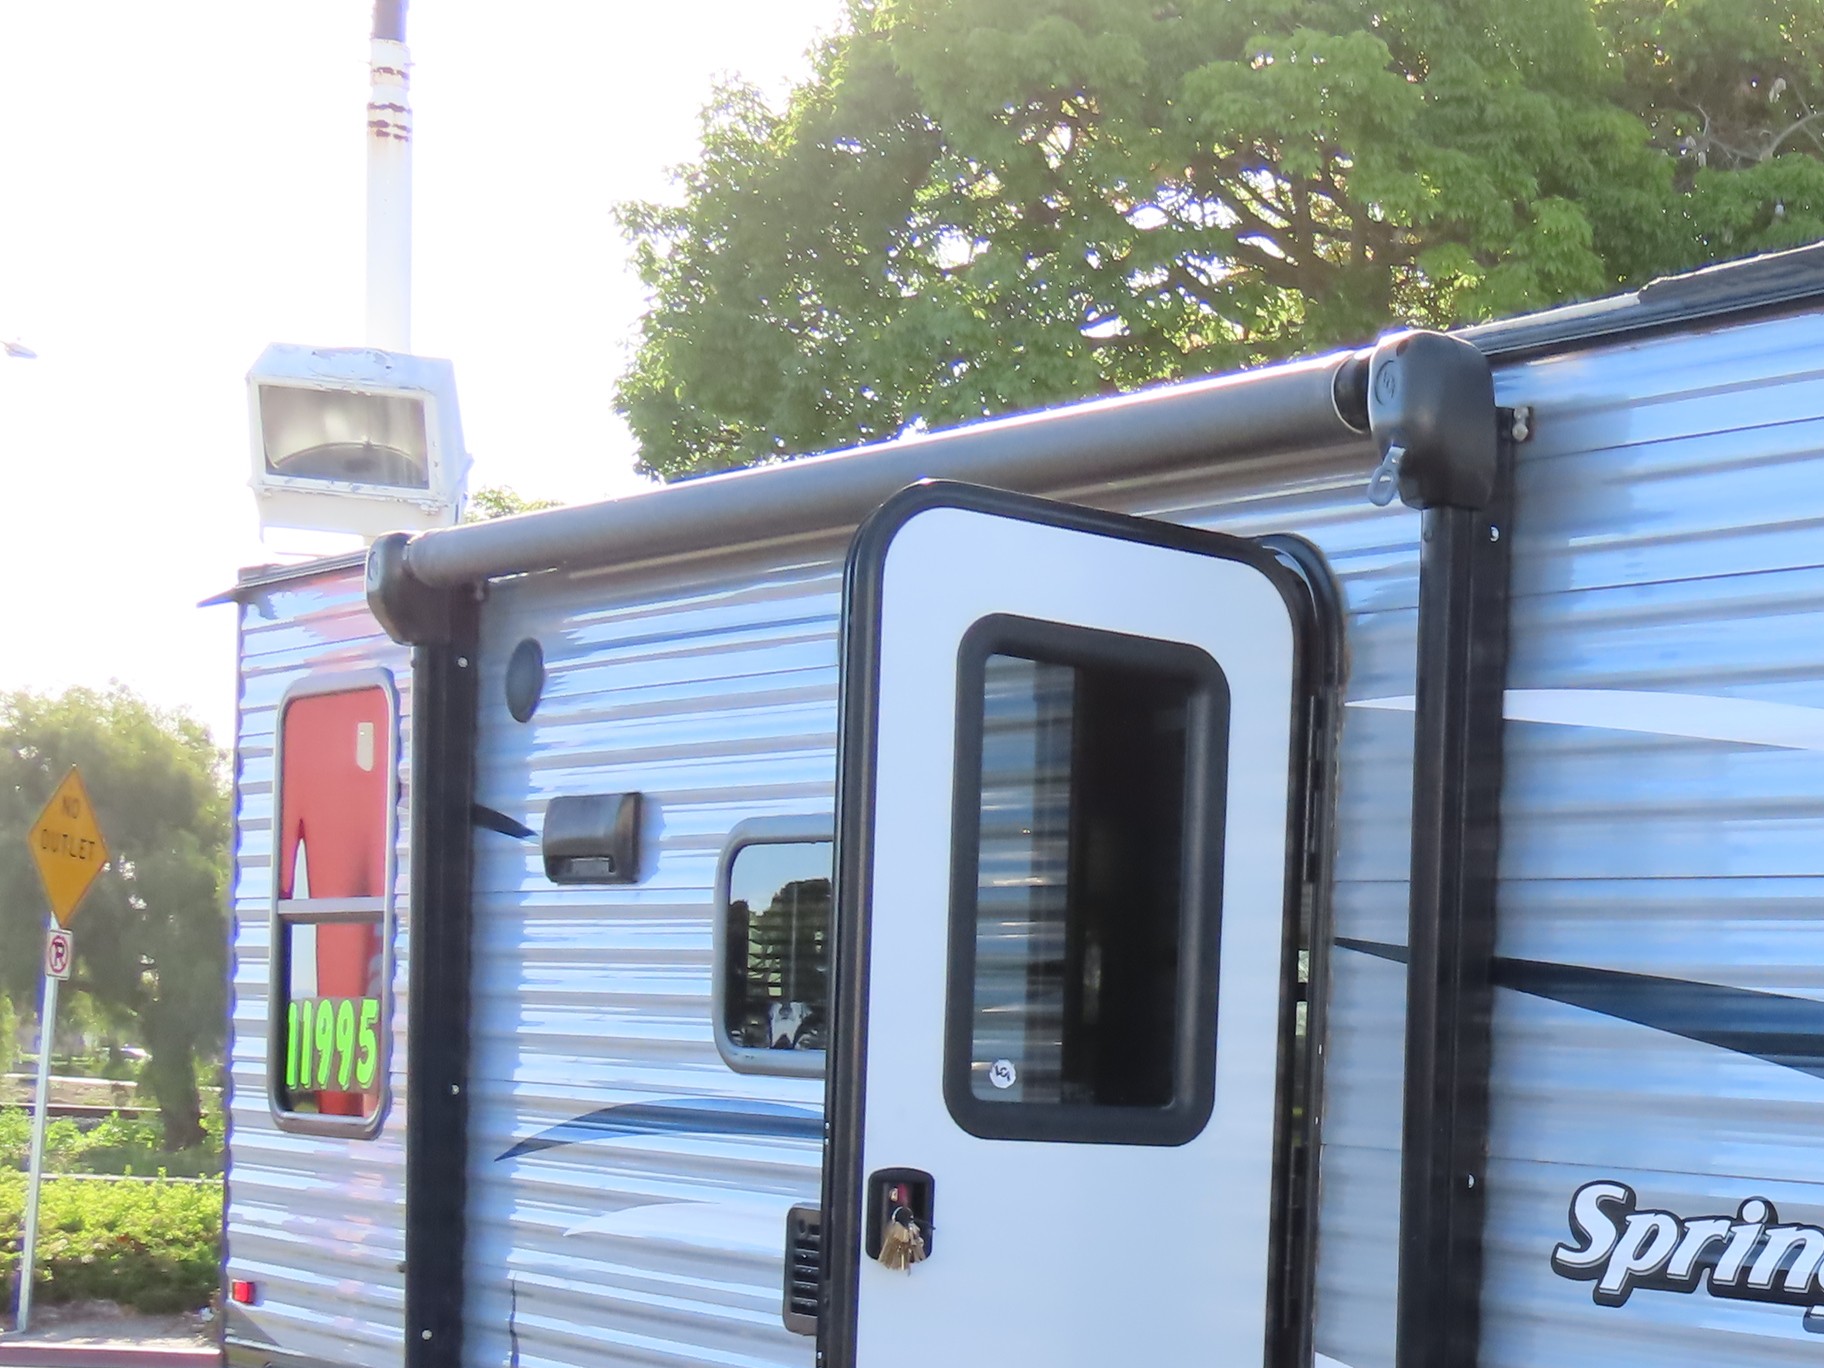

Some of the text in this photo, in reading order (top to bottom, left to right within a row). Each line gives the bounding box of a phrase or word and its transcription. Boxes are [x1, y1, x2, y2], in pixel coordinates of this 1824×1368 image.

[62, 796, 80, 819] NO
[41, 828, 95, 860] OUTLET
[285, 998, 379, 1090] 11995
